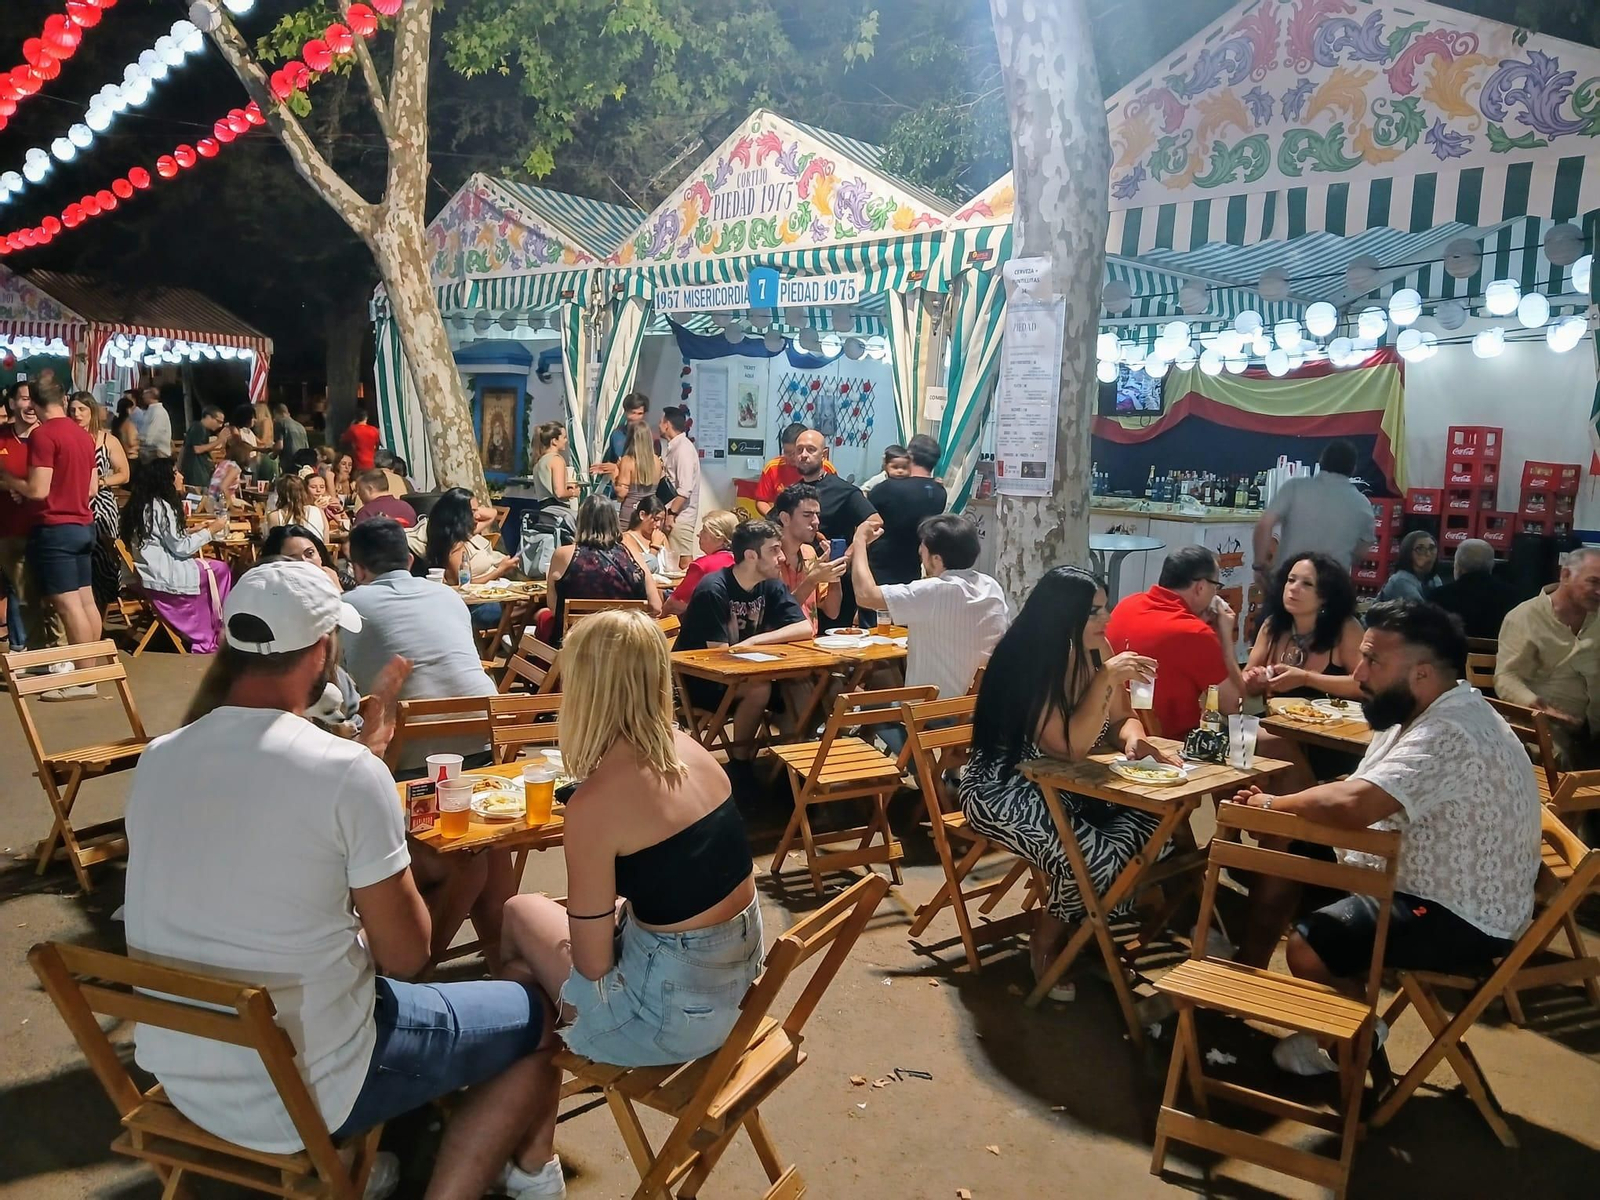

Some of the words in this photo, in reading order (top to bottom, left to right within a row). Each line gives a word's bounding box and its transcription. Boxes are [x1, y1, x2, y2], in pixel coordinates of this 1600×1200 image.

[737, 168, 768, 188] CORTIJO
[713, 187, 755, 221] PIEDAD
[760, 181, 794, 214] 1975
[656, 289, 679, 310] 1957
[683, 284, 750, 309] MISERICORDIA
[758, 278, 766, 300] 7
[780, 281, 819, 303] PIEDAD
[823, 278, 855, 301] 1975
